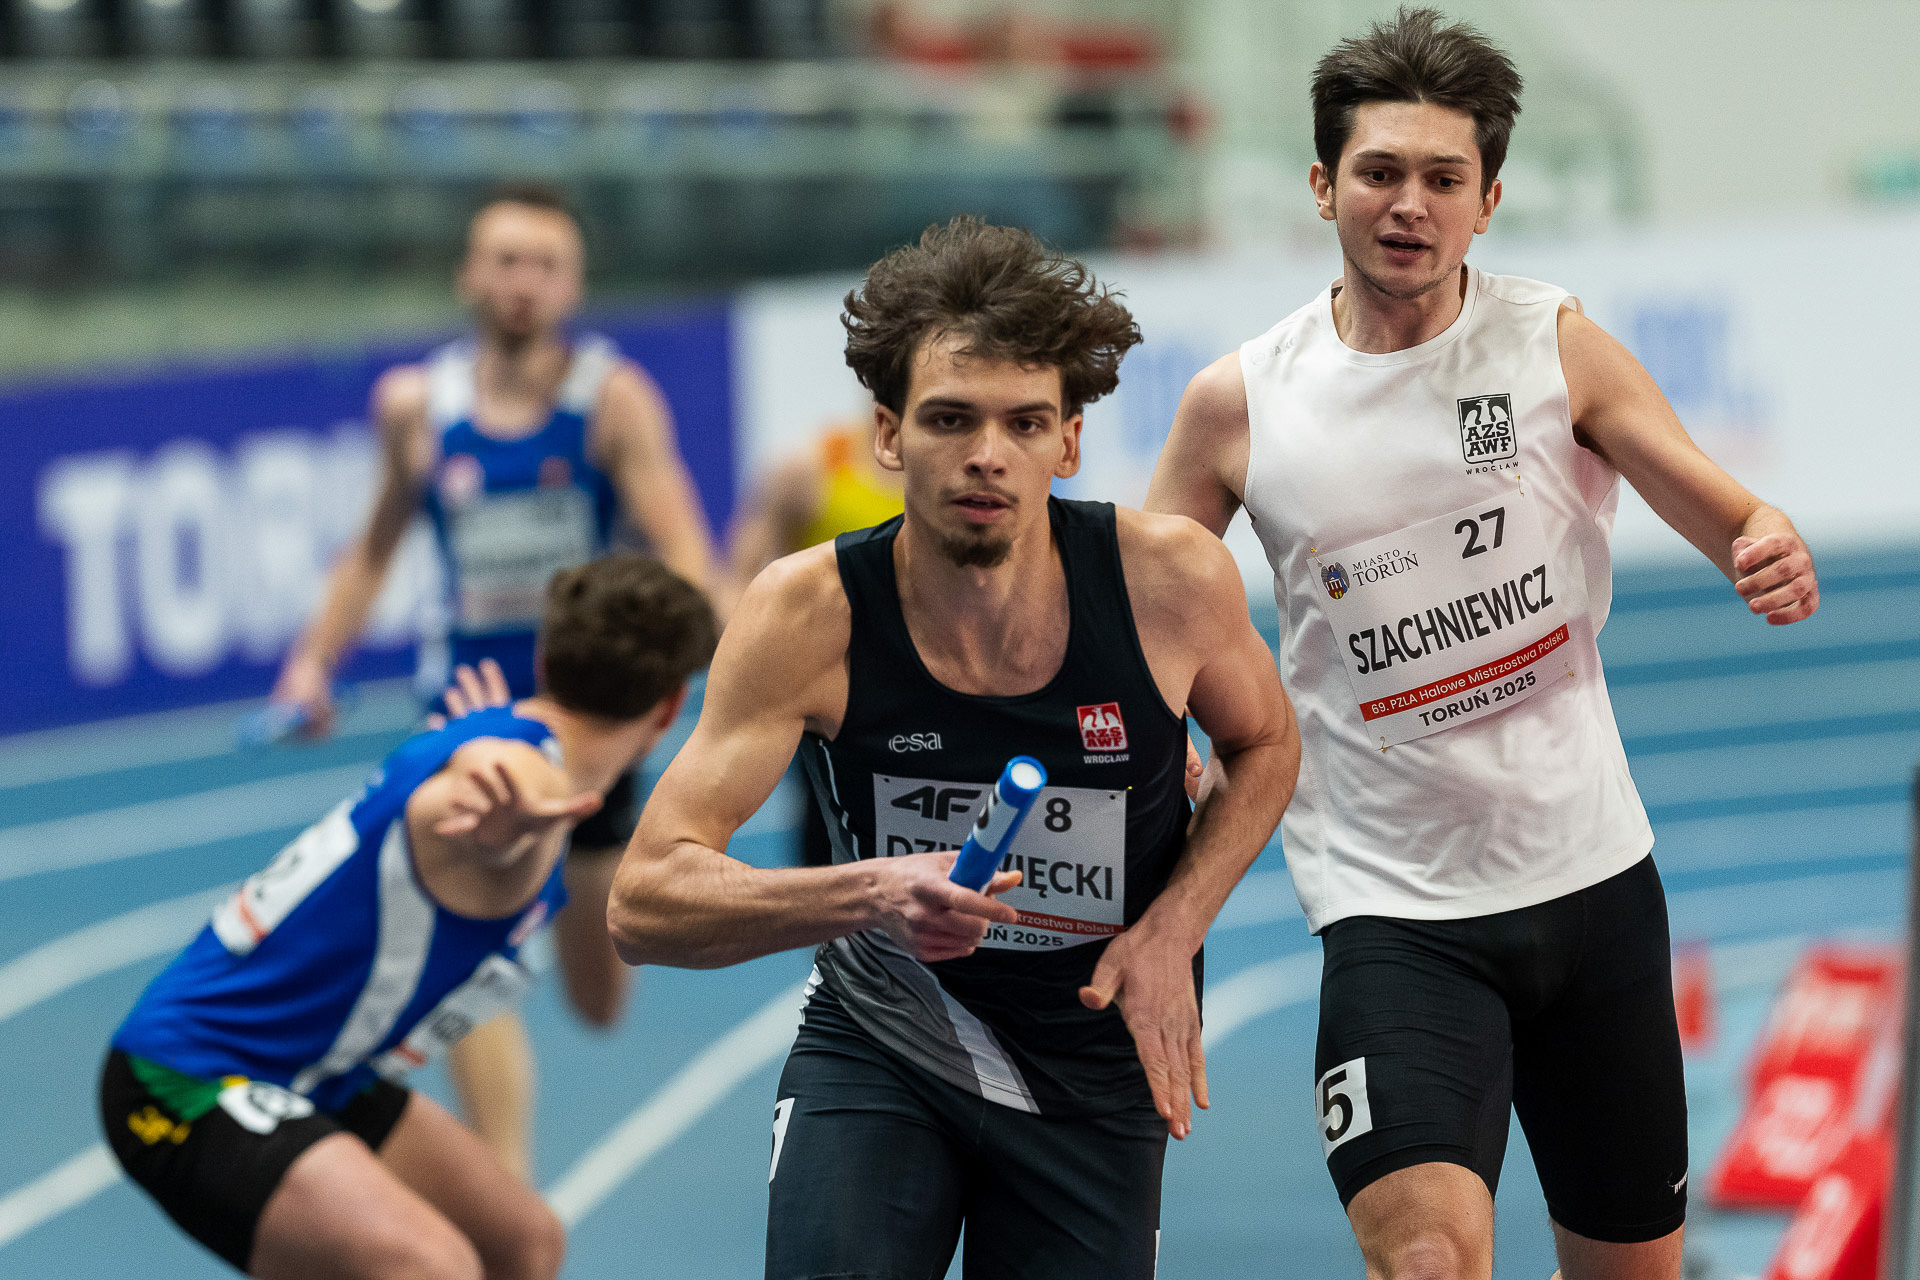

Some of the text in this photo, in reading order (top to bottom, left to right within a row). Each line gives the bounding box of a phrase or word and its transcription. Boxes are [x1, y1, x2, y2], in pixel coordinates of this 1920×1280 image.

[1465, 420, 1510, 443] AZS
[1467, 436, 1512, 457] AWF
[1465, 461, 1519, 475] WROCŁAW
[1454, 506, 1506, 560] 27
[1352, 549, 1400, 571] MIASTO
[1352, 551, 1419, 587] TORUŃ
[1348, 563, 1554, 675] SZACHNIEWICZ
[1371, 629, 1564, 715] 69. PZLA Halowe Mistrzostwa Polski
[1418, 670, 1537, 727] TORUŃ 2025
[888, 732, 943, 753] esa
[1085, 726, 1123, 739] AZS
[1087, 736, 1124, 748] AWF
[890, 785, 982, 822] 4F
[1044, 796, 1073, 833] 8
[1017, 913, 1116, 934] trzostwa Polski
[1012, 930, 1065, 947] 2025
[1322, 1068, 1354, 1142] 5
